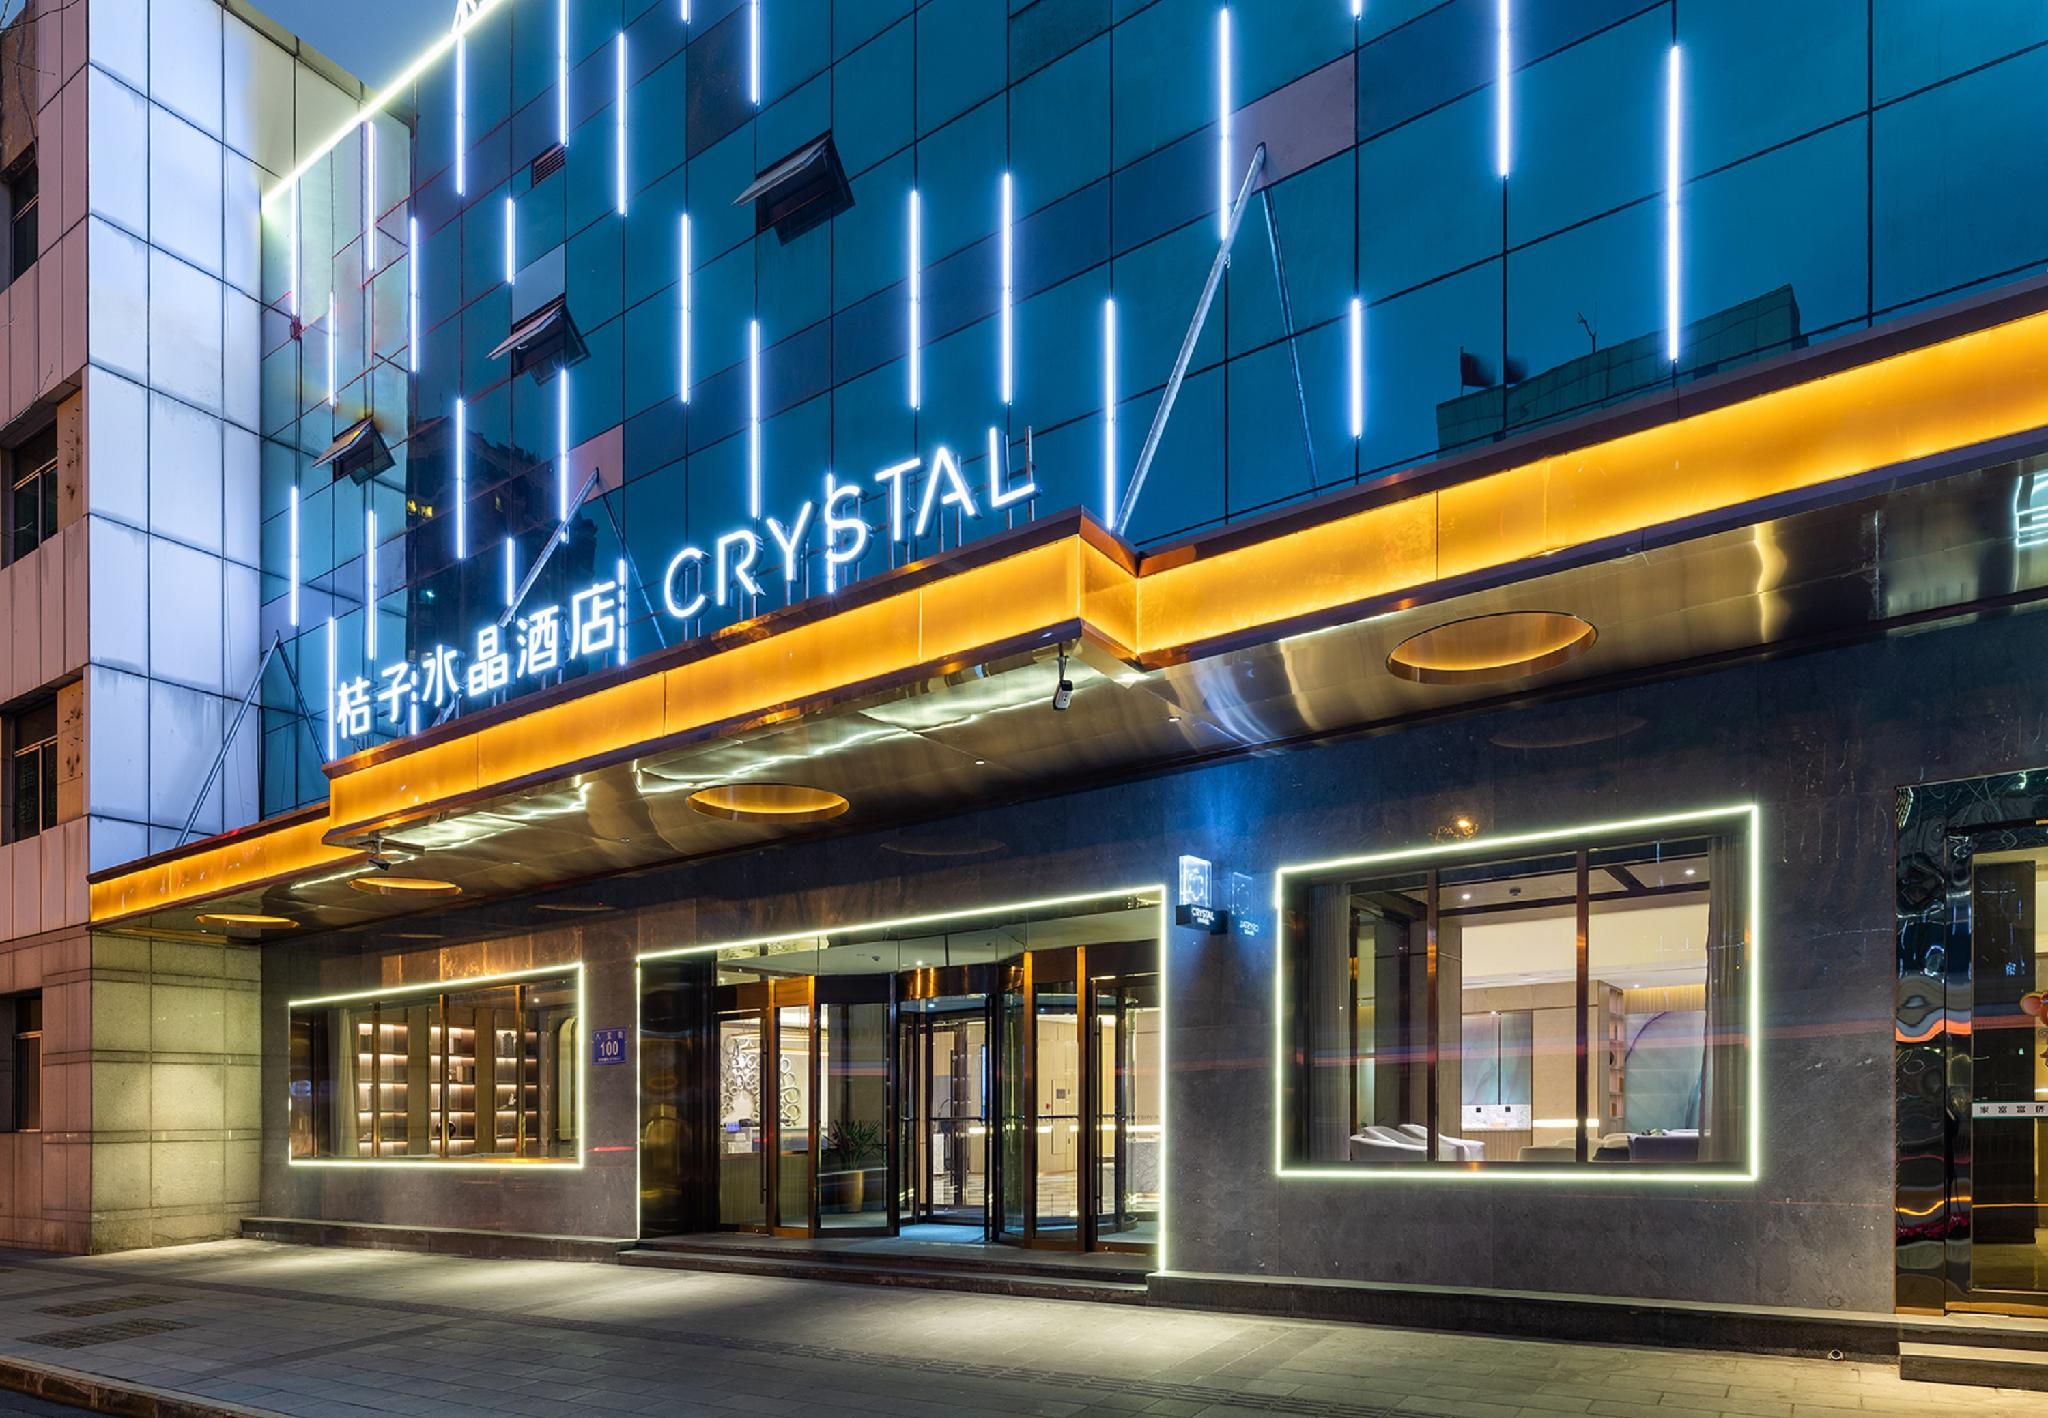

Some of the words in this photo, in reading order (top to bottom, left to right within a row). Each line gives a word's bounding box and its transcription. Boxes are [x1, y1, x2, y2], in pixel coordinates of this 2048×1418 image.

[336, 579, 618, 739] 桔子水晶酒店
[663, 426, 1036, 618] CRYSTAL
[1191, 907, 1215, 921] CRYSTAL
[600, 1040, 619, 1057] 100
